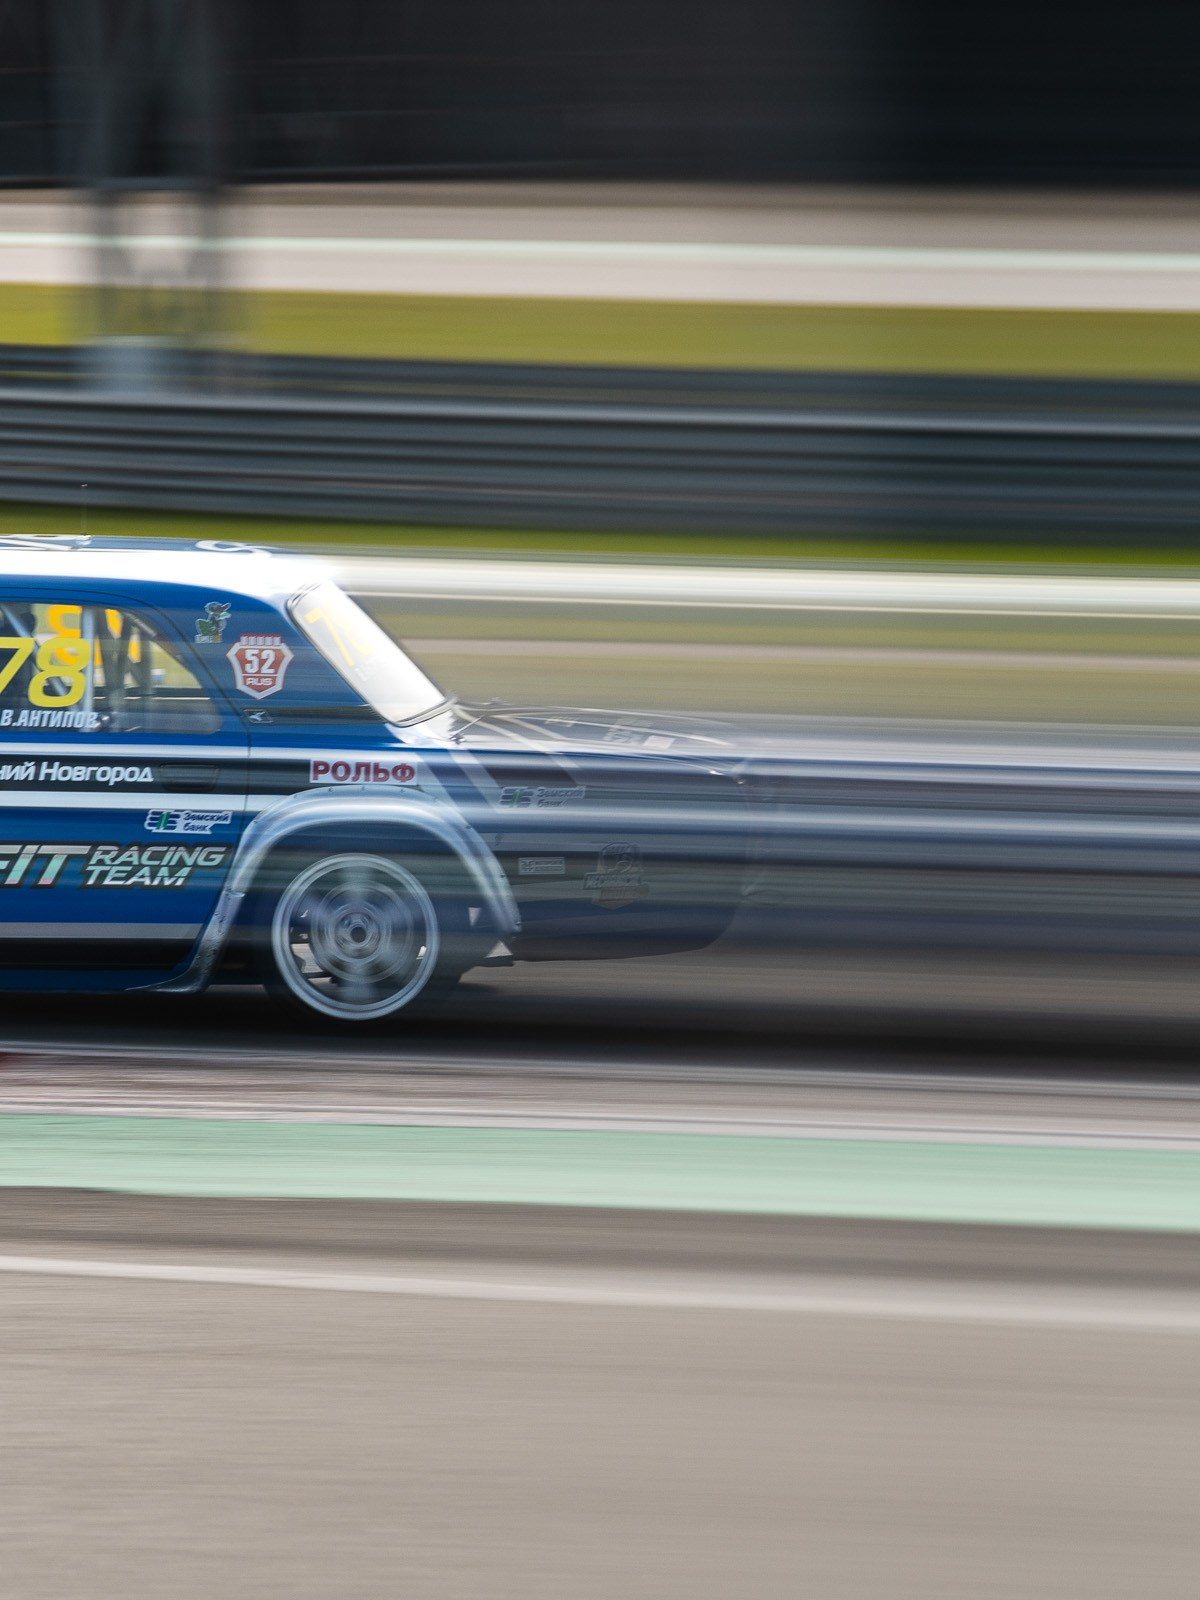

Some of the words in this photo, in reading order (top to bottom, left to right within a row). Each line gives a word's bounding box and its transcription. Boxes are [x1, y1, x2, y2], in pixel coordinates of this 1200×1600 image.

[245, 649, 276, 674] 52
[246, 678, 273, 686] RUS
[38, 761, 154, 786] Новгород
[312, 760, 416, 783] РОЛЬФ
[183, 811, 230, 822] Земский
[88, 845, 227, 867] RACING
[86, 866, 193, 886] TEAM
